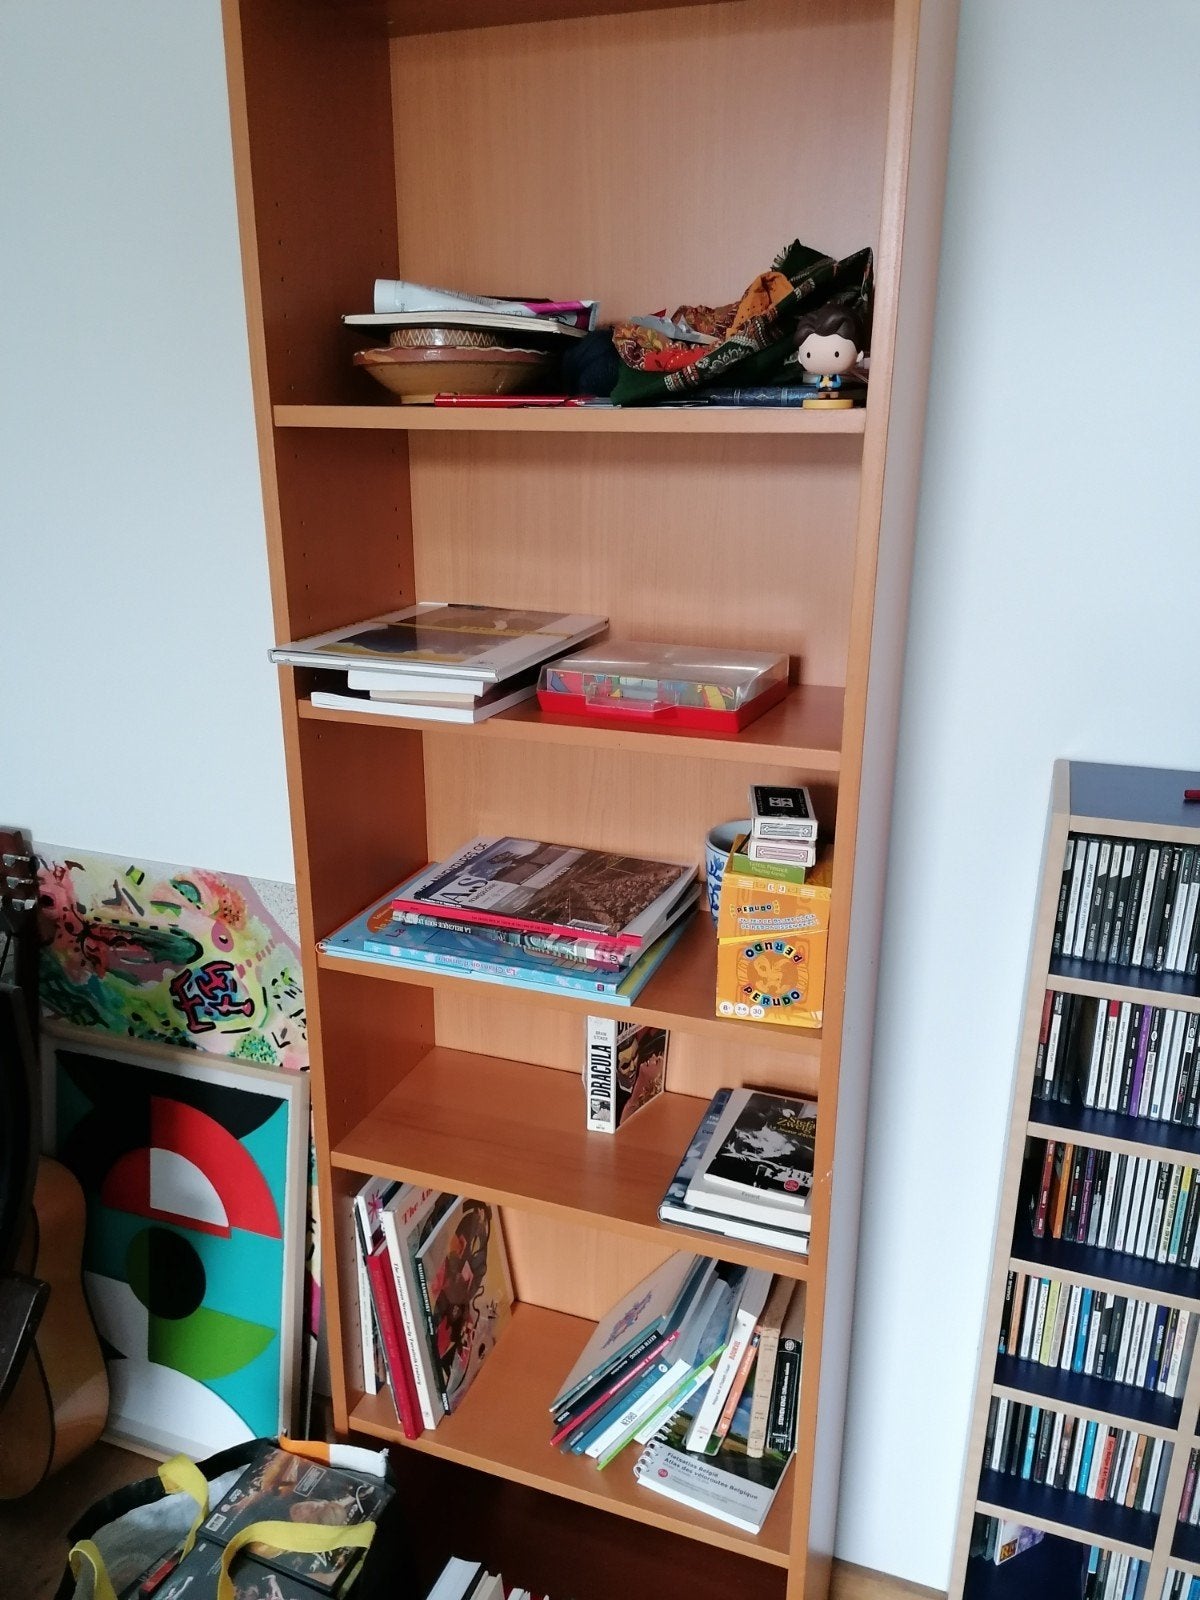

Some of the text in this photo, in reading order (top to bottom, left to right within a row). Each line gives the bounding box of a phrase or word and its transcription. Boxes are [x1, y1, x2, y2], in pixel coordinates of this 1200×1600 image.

[1159, 863, 1167, 880] Pepper
[737, 903, 773, 914] PERUDO
[745, 941, 803, 964] PERUDO
[437, 955, 515, 976] La Chanson d'amour
[743, 985, 800, 1007] PERUDO
[591, 1045, 611, 1098] DRACULA
[401, 1200, 420, 1224] The
[417, 1281, 433, 1313] KANDINSKY
[395, 1274, 405, 1300] American
[408, 1338, 418, 1363] Twentieth
[626, 1333, 657, 1360] KEITH HARING
[666, 1452, 720, 1477] Fietsatlas België
[1103, 1450, 1111, 1466] Mulligan
[664, 1457, 759, 1501] Atlas des véloroutes Belgique
